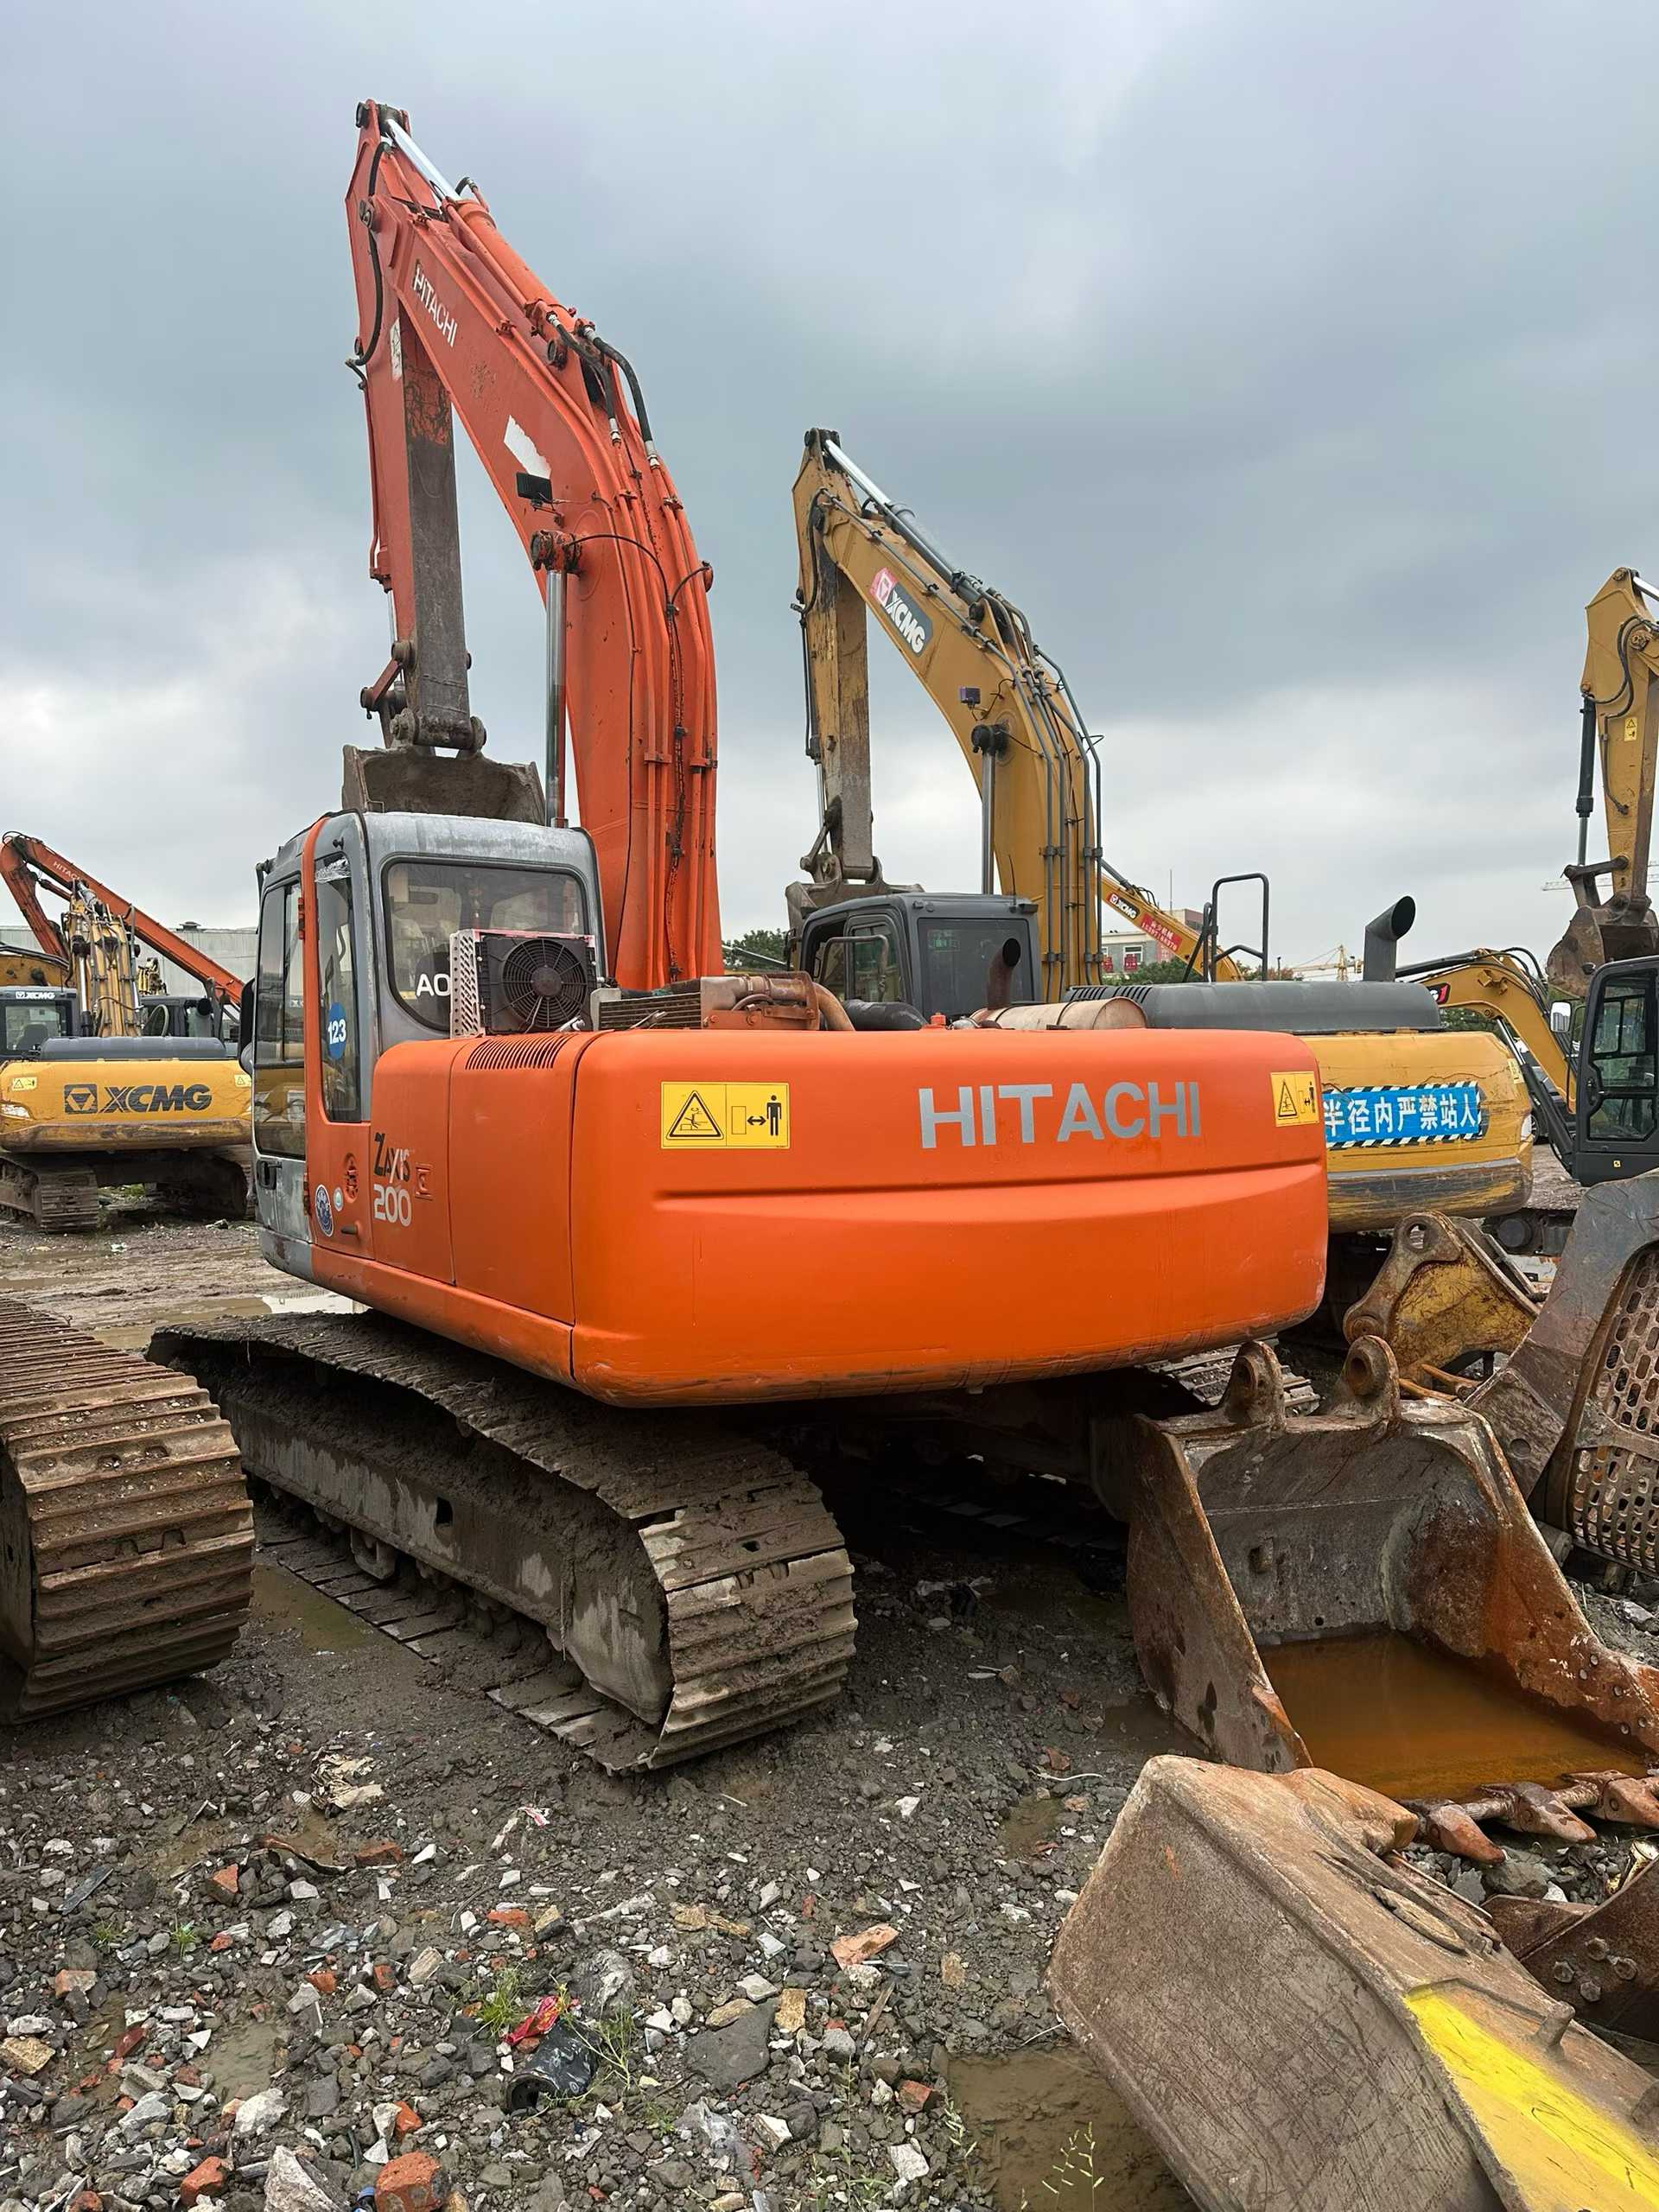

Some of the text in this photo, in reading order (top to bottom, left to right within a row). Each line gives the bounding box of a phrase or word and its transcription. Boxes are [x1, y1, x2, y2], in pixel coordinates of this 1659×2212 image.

[413, 266, 458, 348] HITACHI
[885, 589, 925, 653] XCMG
[1116, 898, 1137, 918] XCMG
[327, 1019, 346, 1045] 123
[98, 1084, 213, 1113] XCMG
[918, 1081, 1202, 1149] HITACHI
[1323, 1092, 1476, 1137] 半径内严禁站人
[373, 1183, 412, 1227] 200
